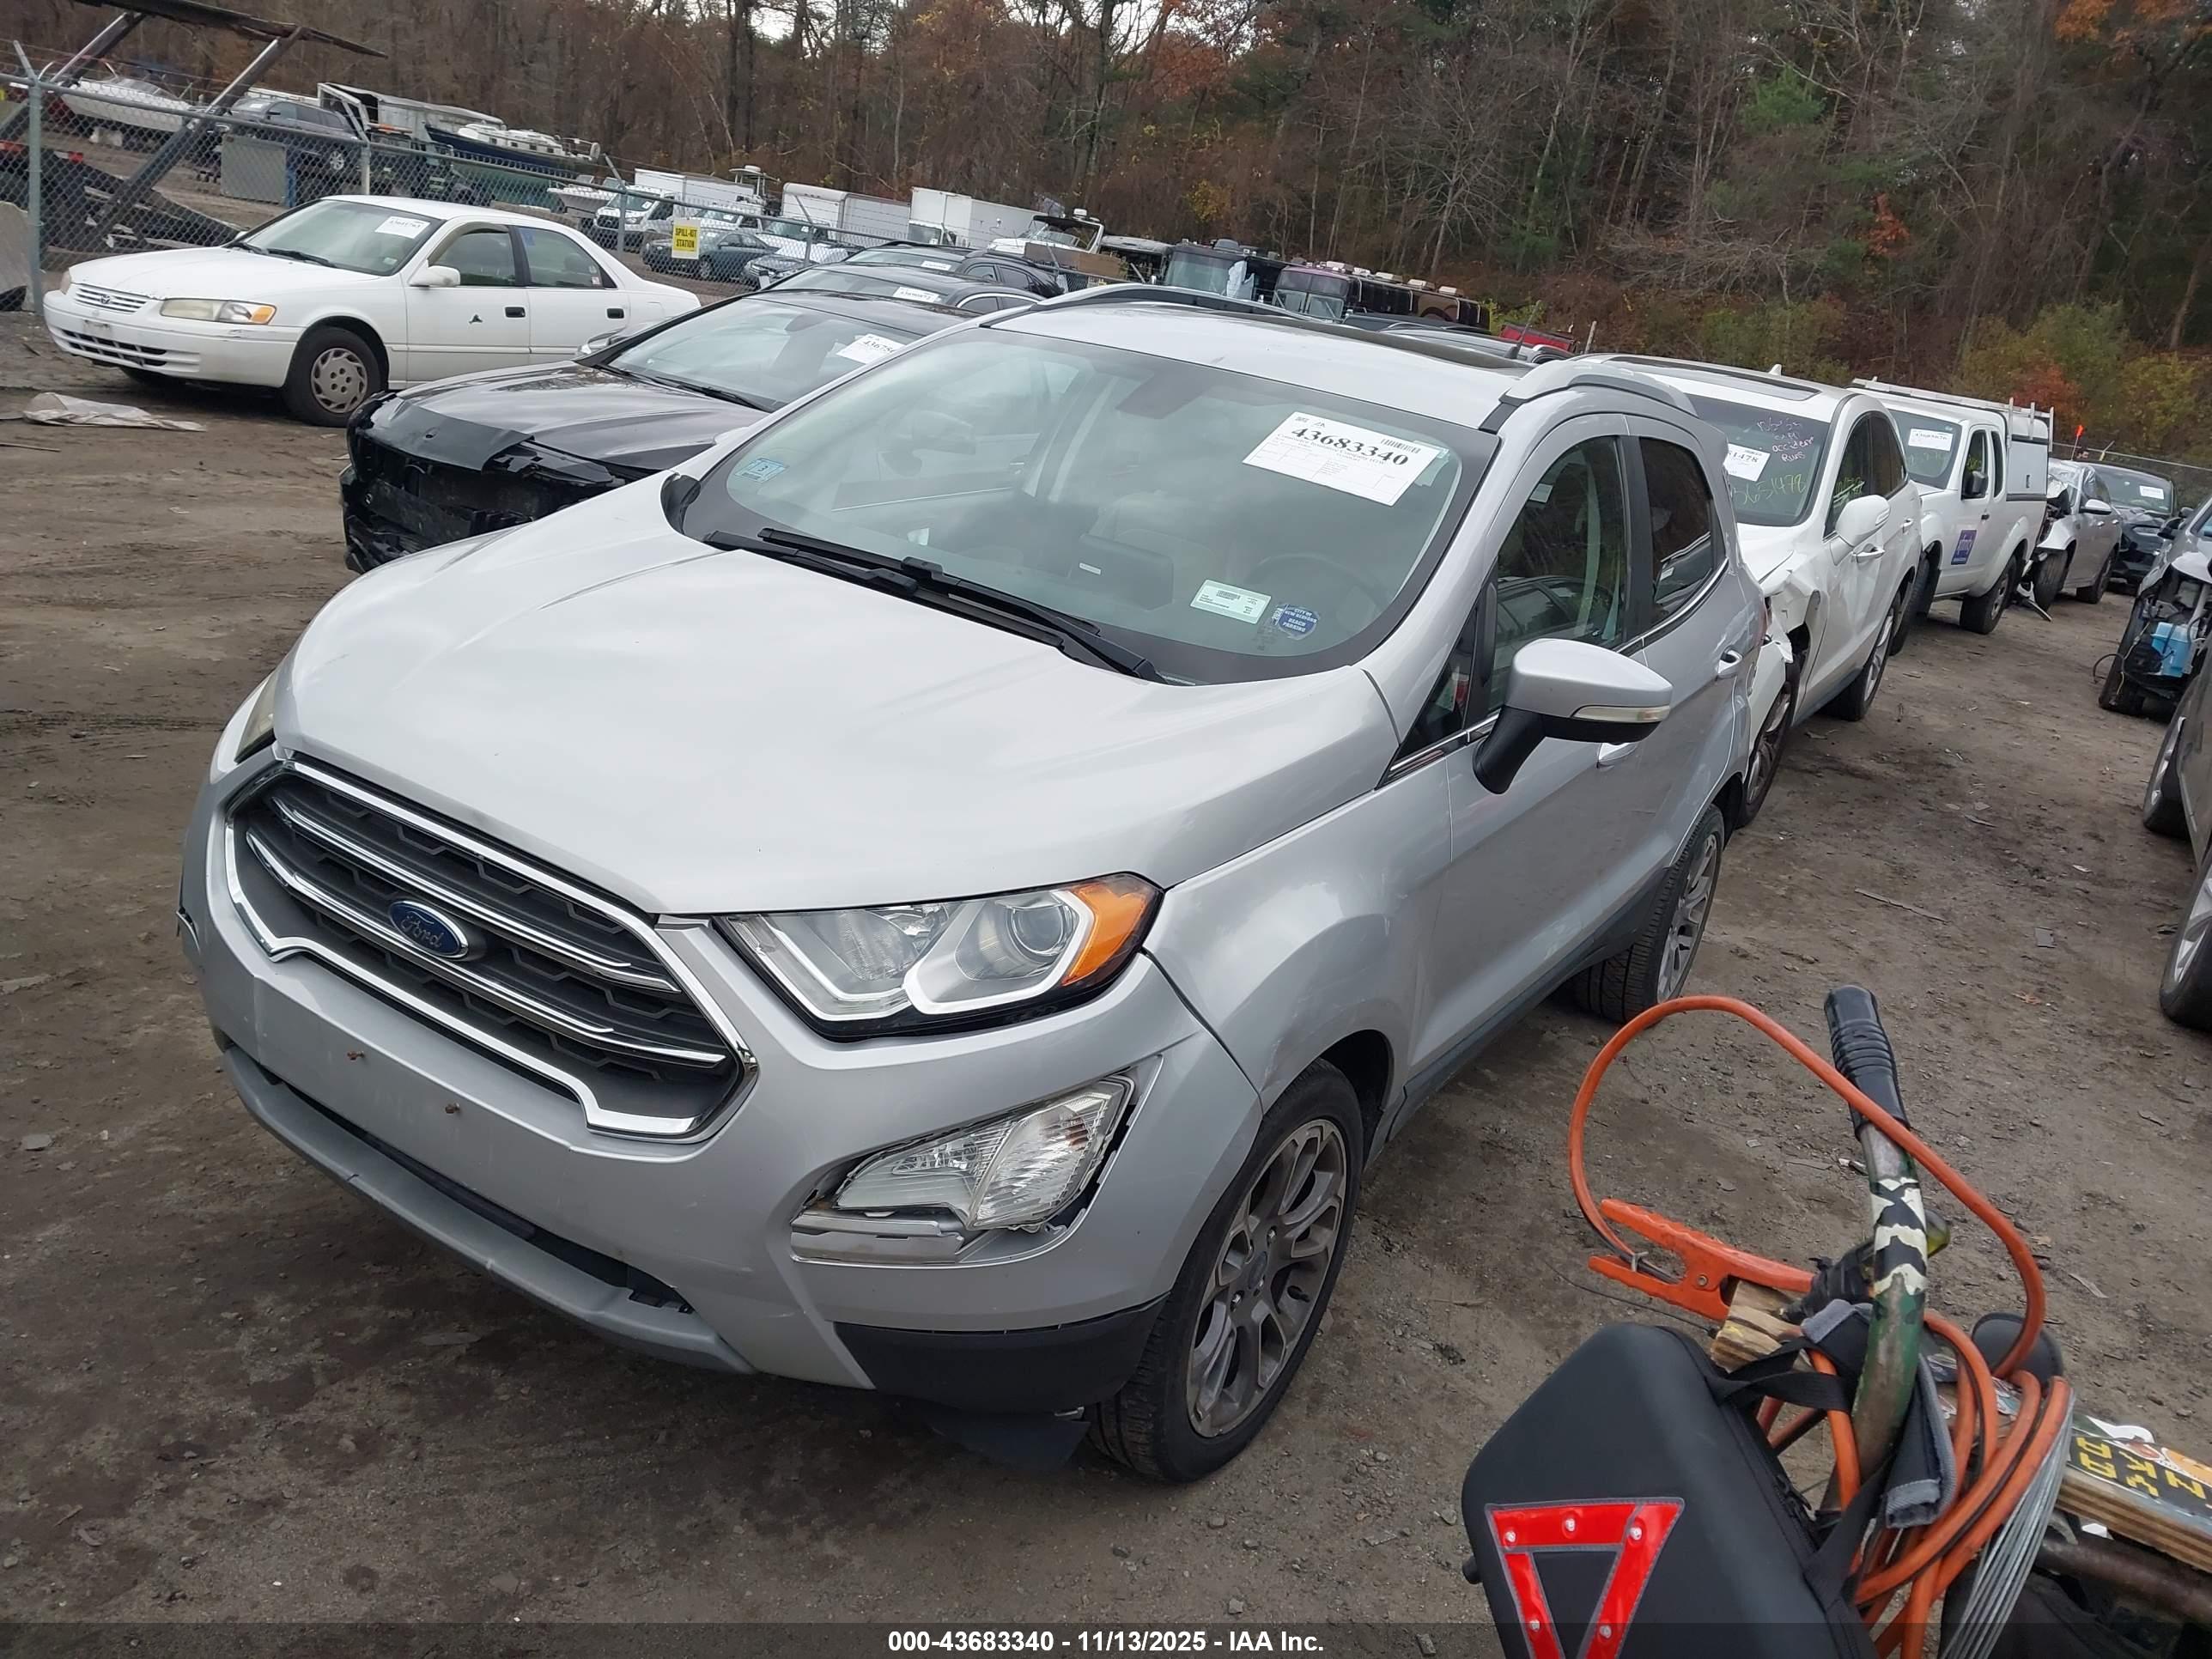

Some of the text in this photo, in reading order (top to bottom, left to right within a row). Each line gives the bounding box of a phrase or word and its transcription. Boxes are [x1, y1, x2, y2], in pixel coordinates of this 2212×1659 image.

[1291, 428, 1409, 465] 43683340
[1282, 622, 1306, 633] PARKING
[1288, 617, 1307, 627] BEACH
[400, 910, 445, 948] Ford
